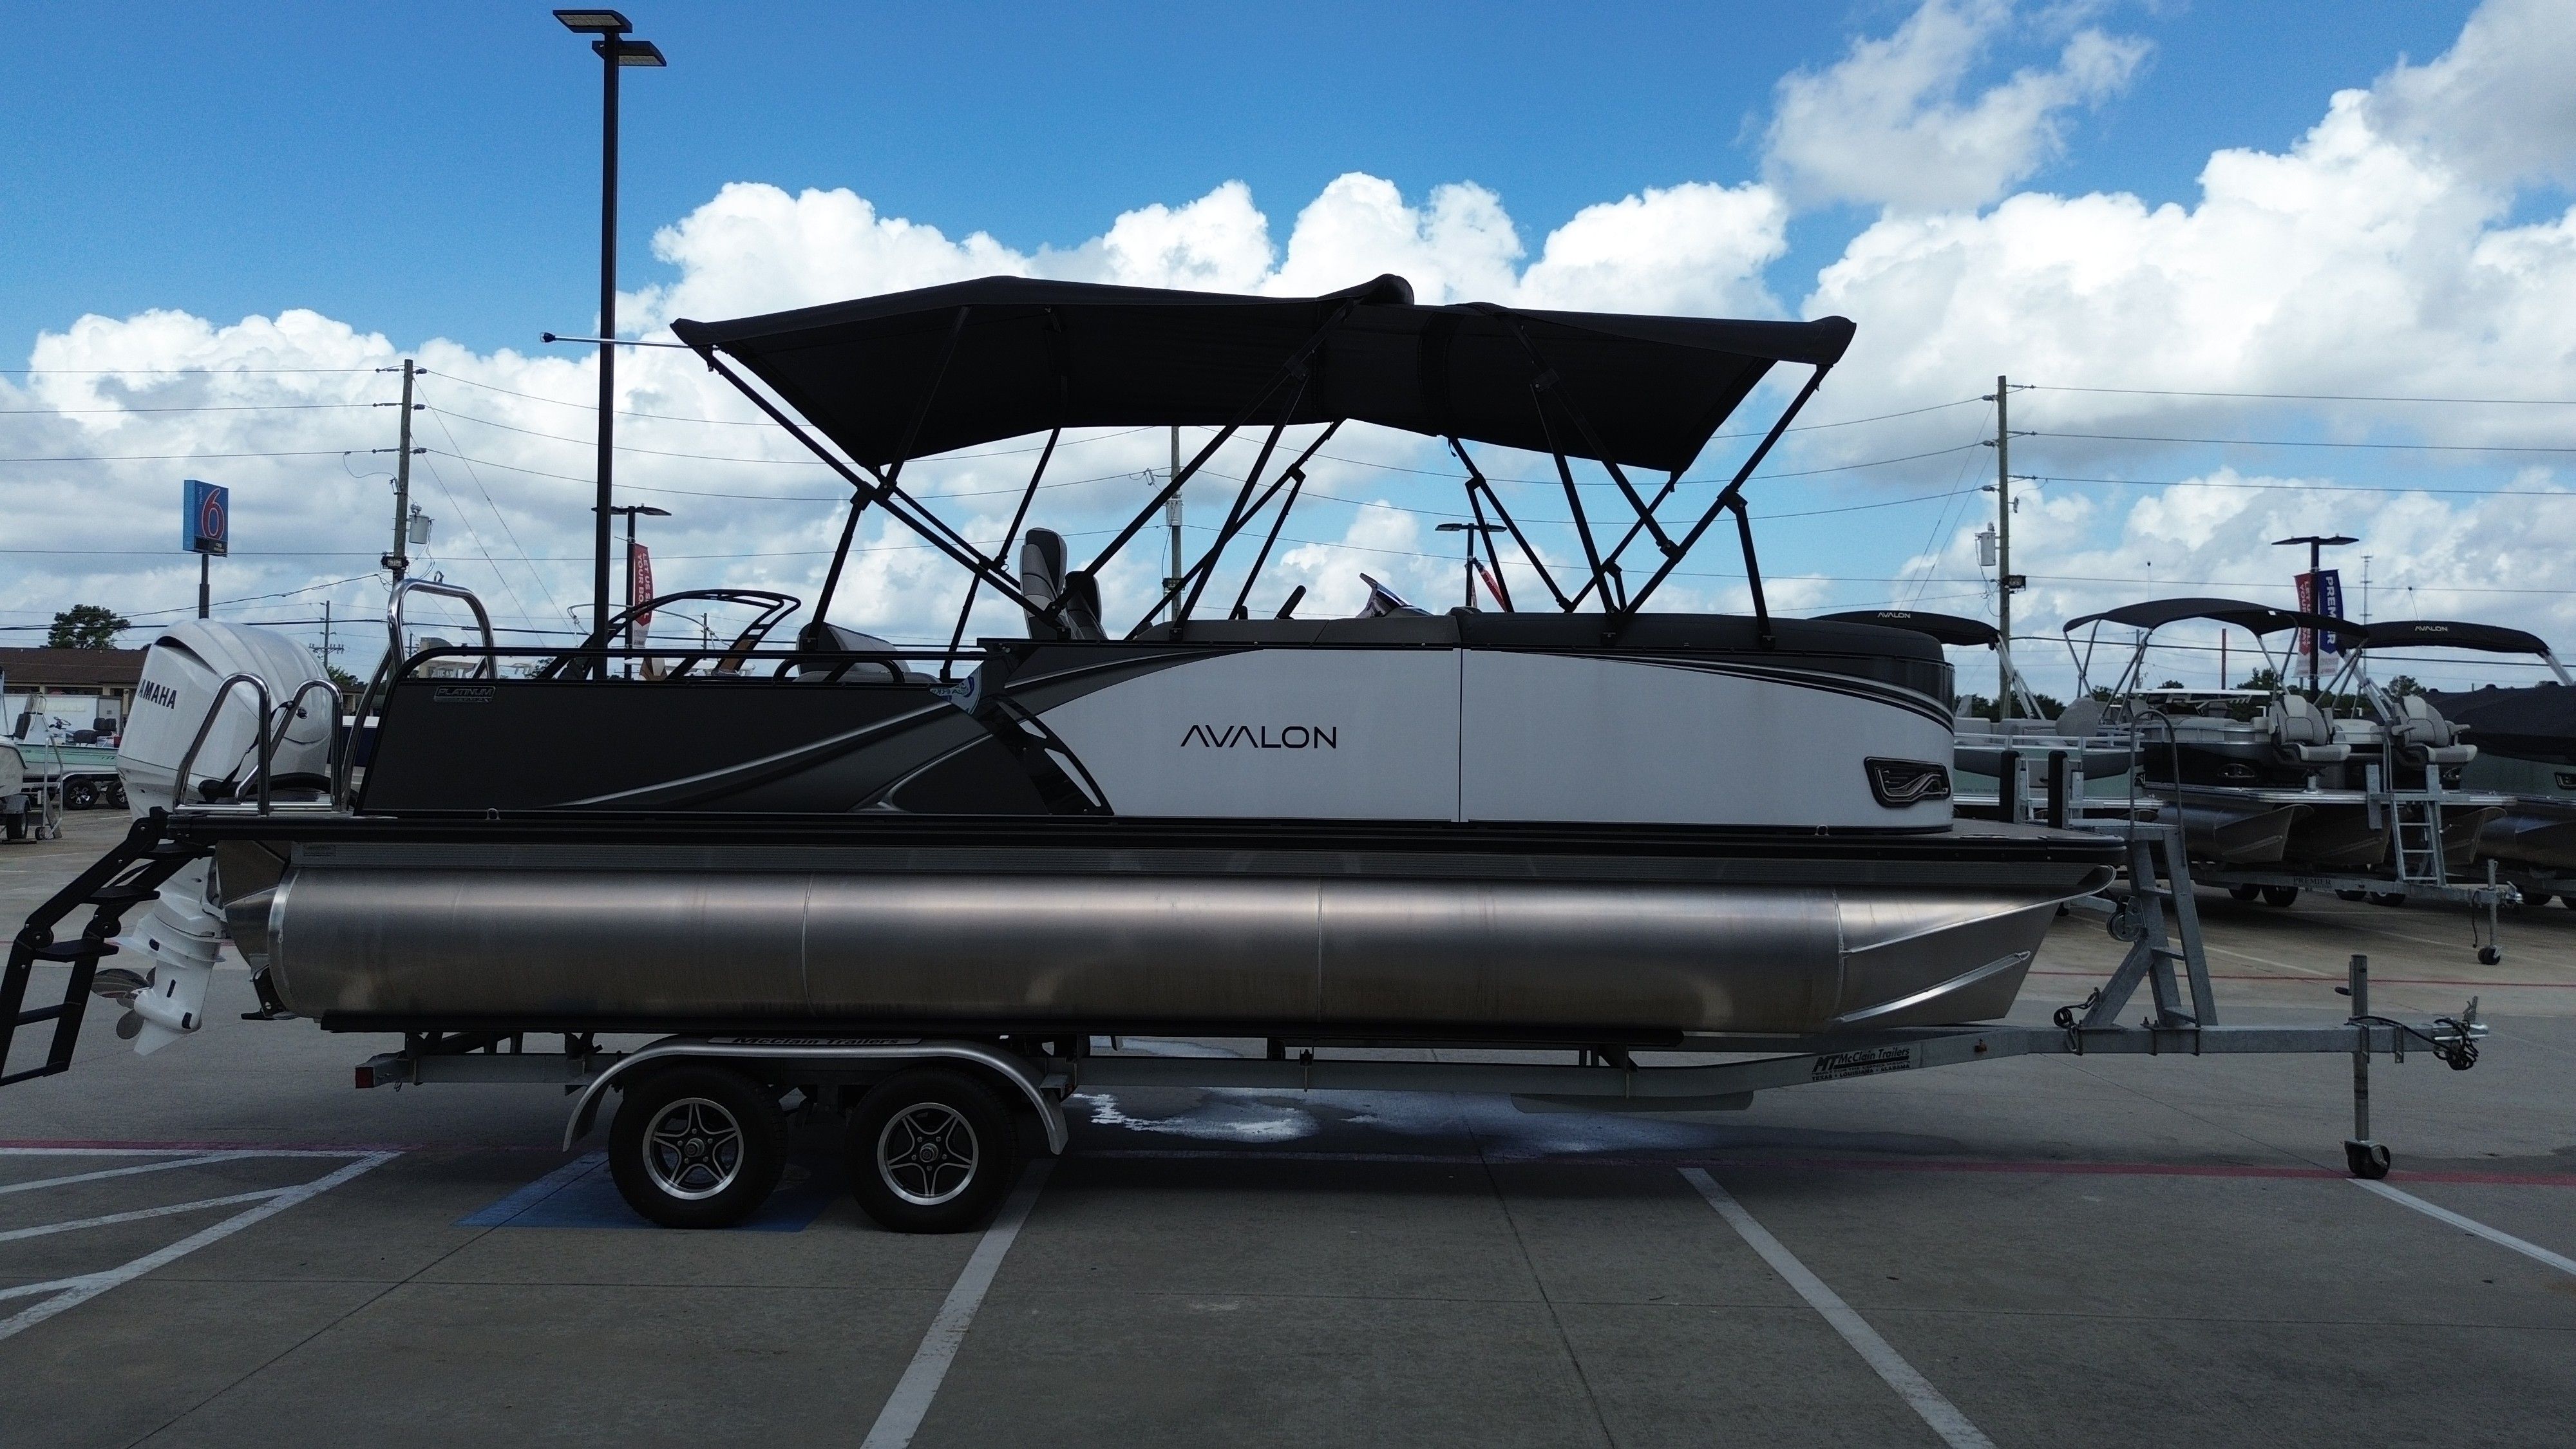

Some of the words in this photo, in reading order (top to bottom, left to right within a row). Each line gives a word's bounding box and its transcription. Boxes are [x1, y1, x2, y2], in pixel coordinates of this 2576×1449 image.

[201, 488, 225, 540] 6
[645, 575, 650, 590] US
[2325, 576, 2337, 645] PREMR
[138, 679, 177, 710] AMAHA
[1180, 724, 1337, 749] AVALON
[1838, 1050, 1876, 1064] McClain
[1878, 1046, 1910, 1059] Trailers
[1839, 1068, 1874, 1078] LOUISIANA
[1880, 1063, 1910, 1072] ALABAMA
